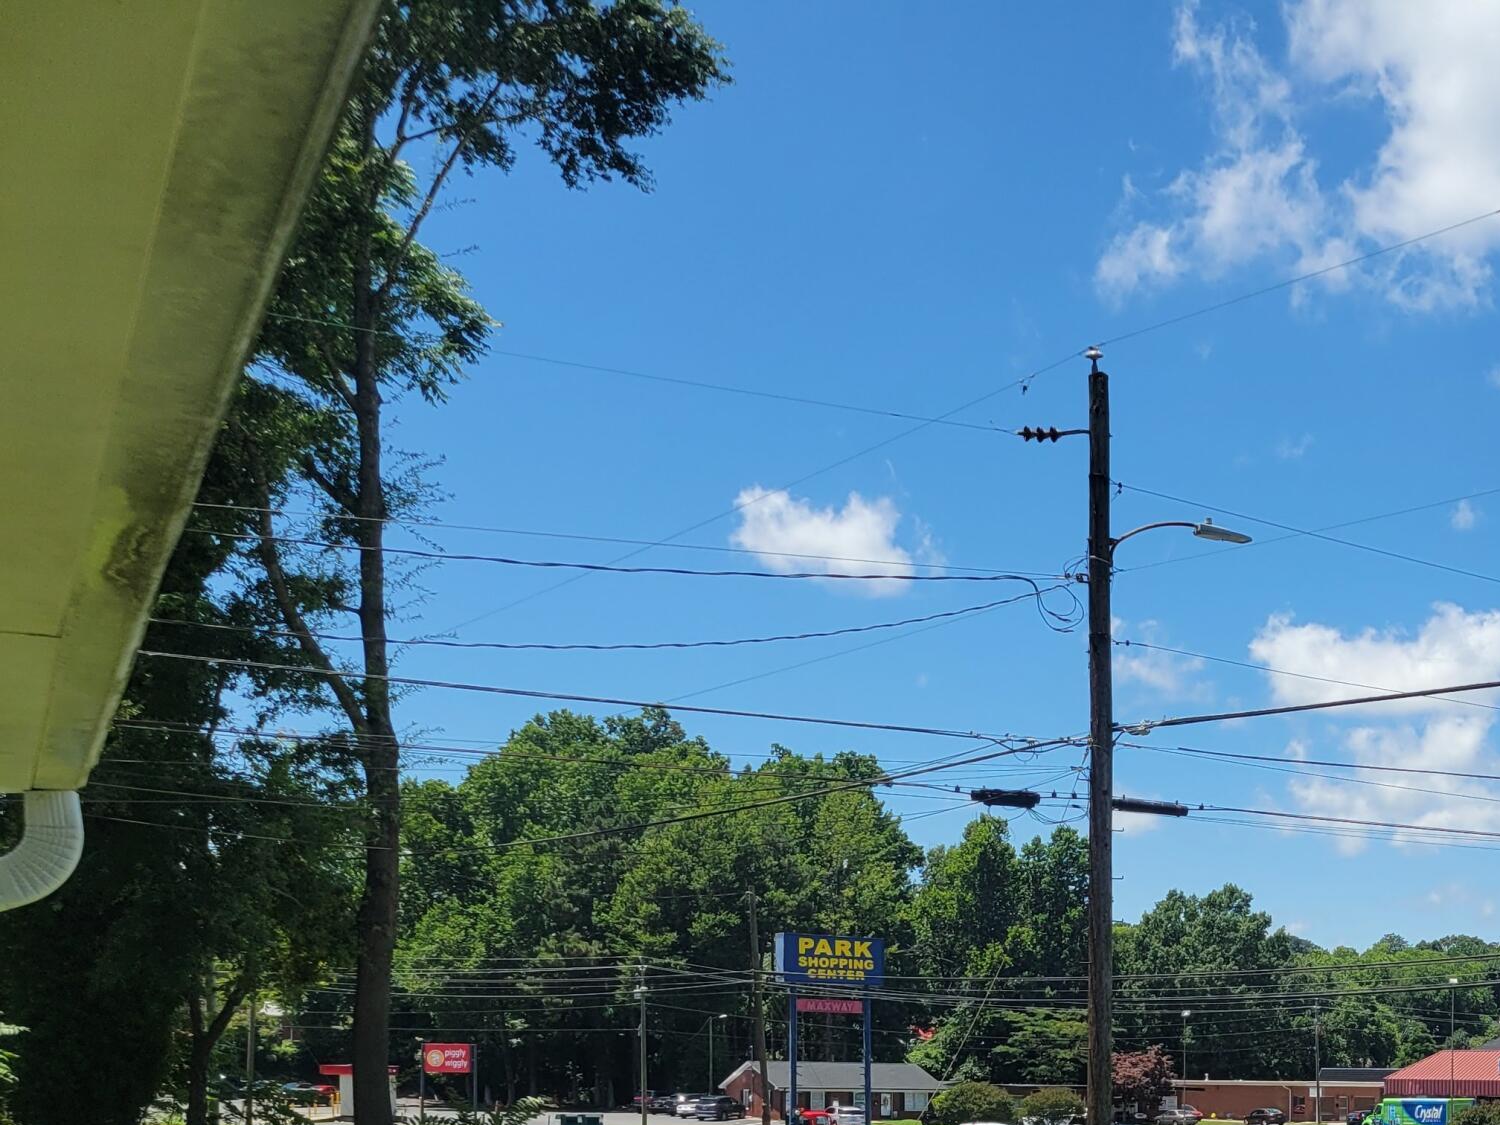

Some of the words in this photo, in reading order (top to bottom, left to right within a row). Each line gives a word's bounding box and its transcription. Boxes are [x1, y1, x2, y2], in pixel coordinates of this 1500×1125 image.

[798, 937, 873, 958] PARK
[798, 956, 875, 970] SHOPPING
[807, 968, 865, 981] CENTER
[806, 1001, 854, 1012] MAXWAY
[444, 1048, 466, 1058] piggly
[444, 1059, 468, 1069] wiggly
[1414, 1104, 1443, 1123] Crystal
